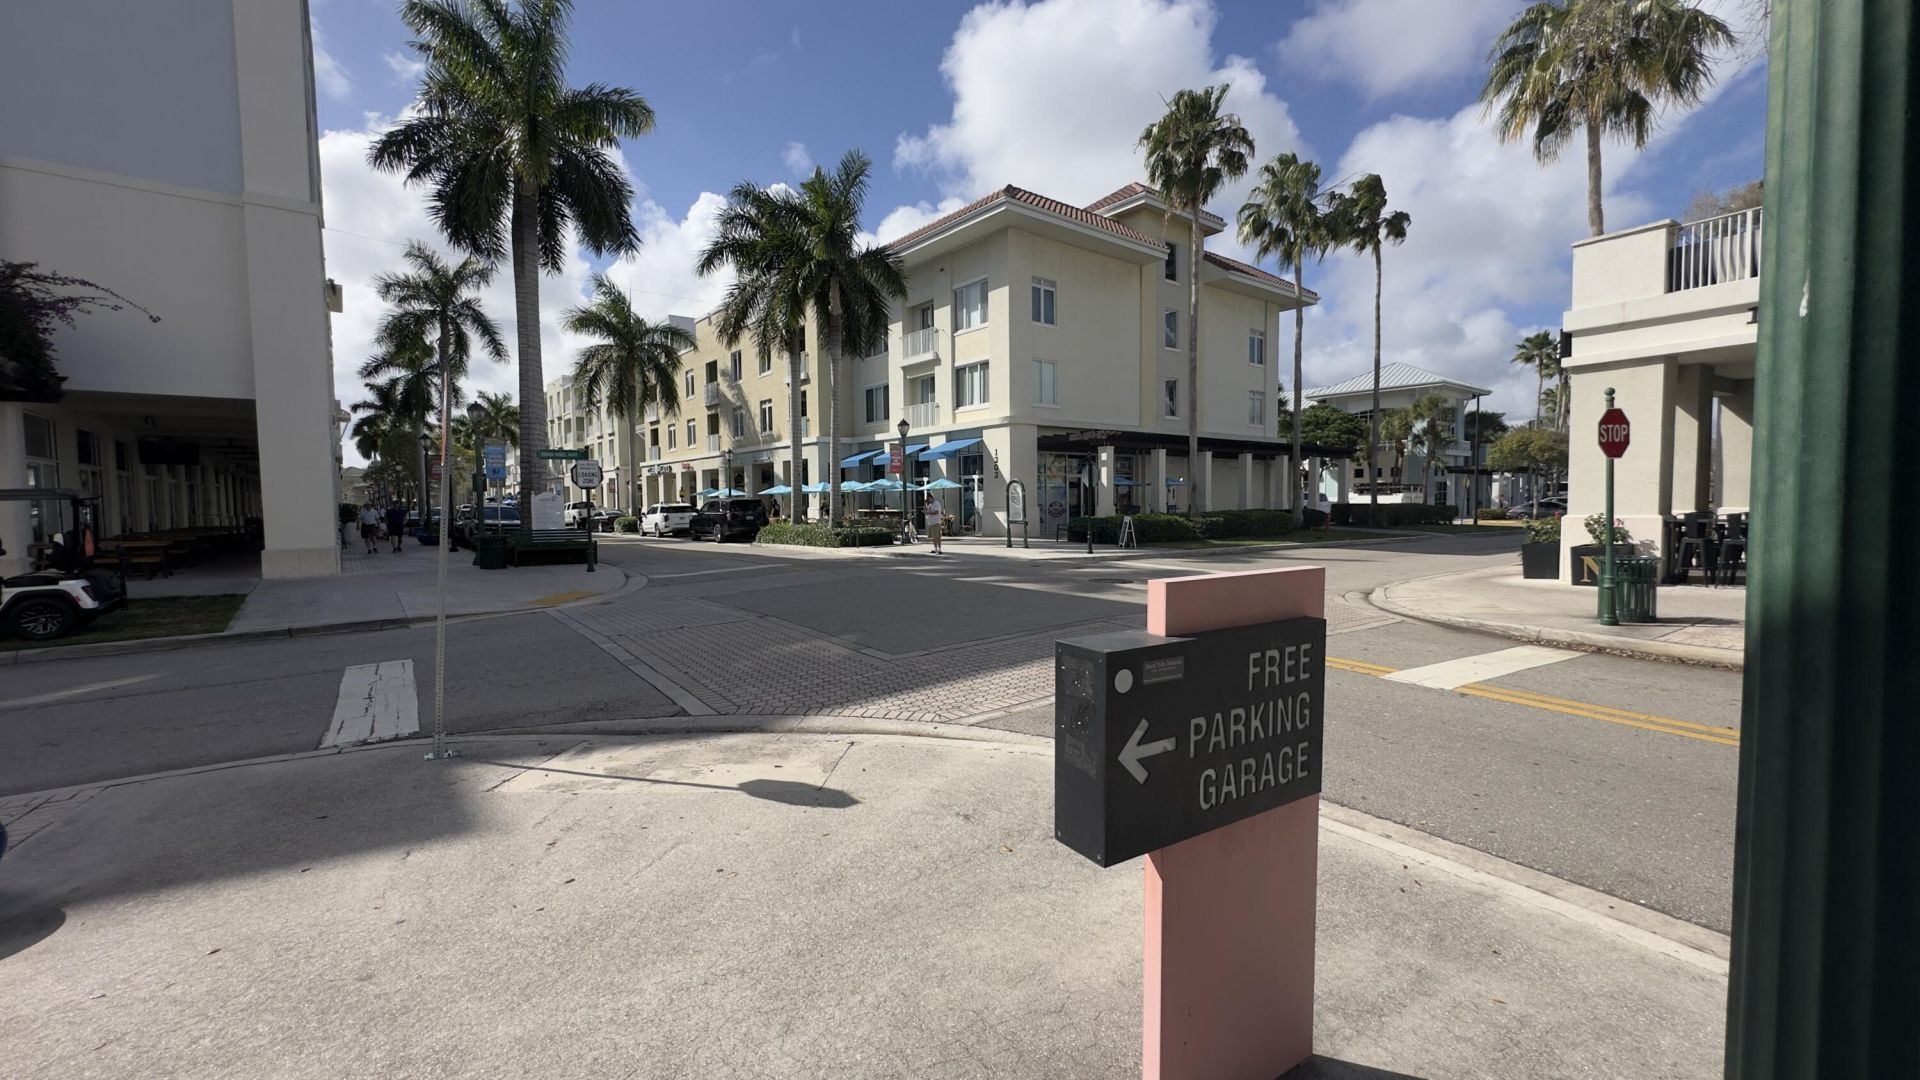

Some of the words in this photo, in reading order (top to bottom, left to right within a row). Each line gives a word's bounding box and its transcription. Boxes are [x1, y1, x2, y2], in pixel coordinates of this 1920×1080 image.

[1600, 424, 1628, 442] STOP
[1249, 643, 1312, 691] FREE
[1189, 692, 1310, 758] PARKING
[1200, 742, 1309, 810] GARAGE
